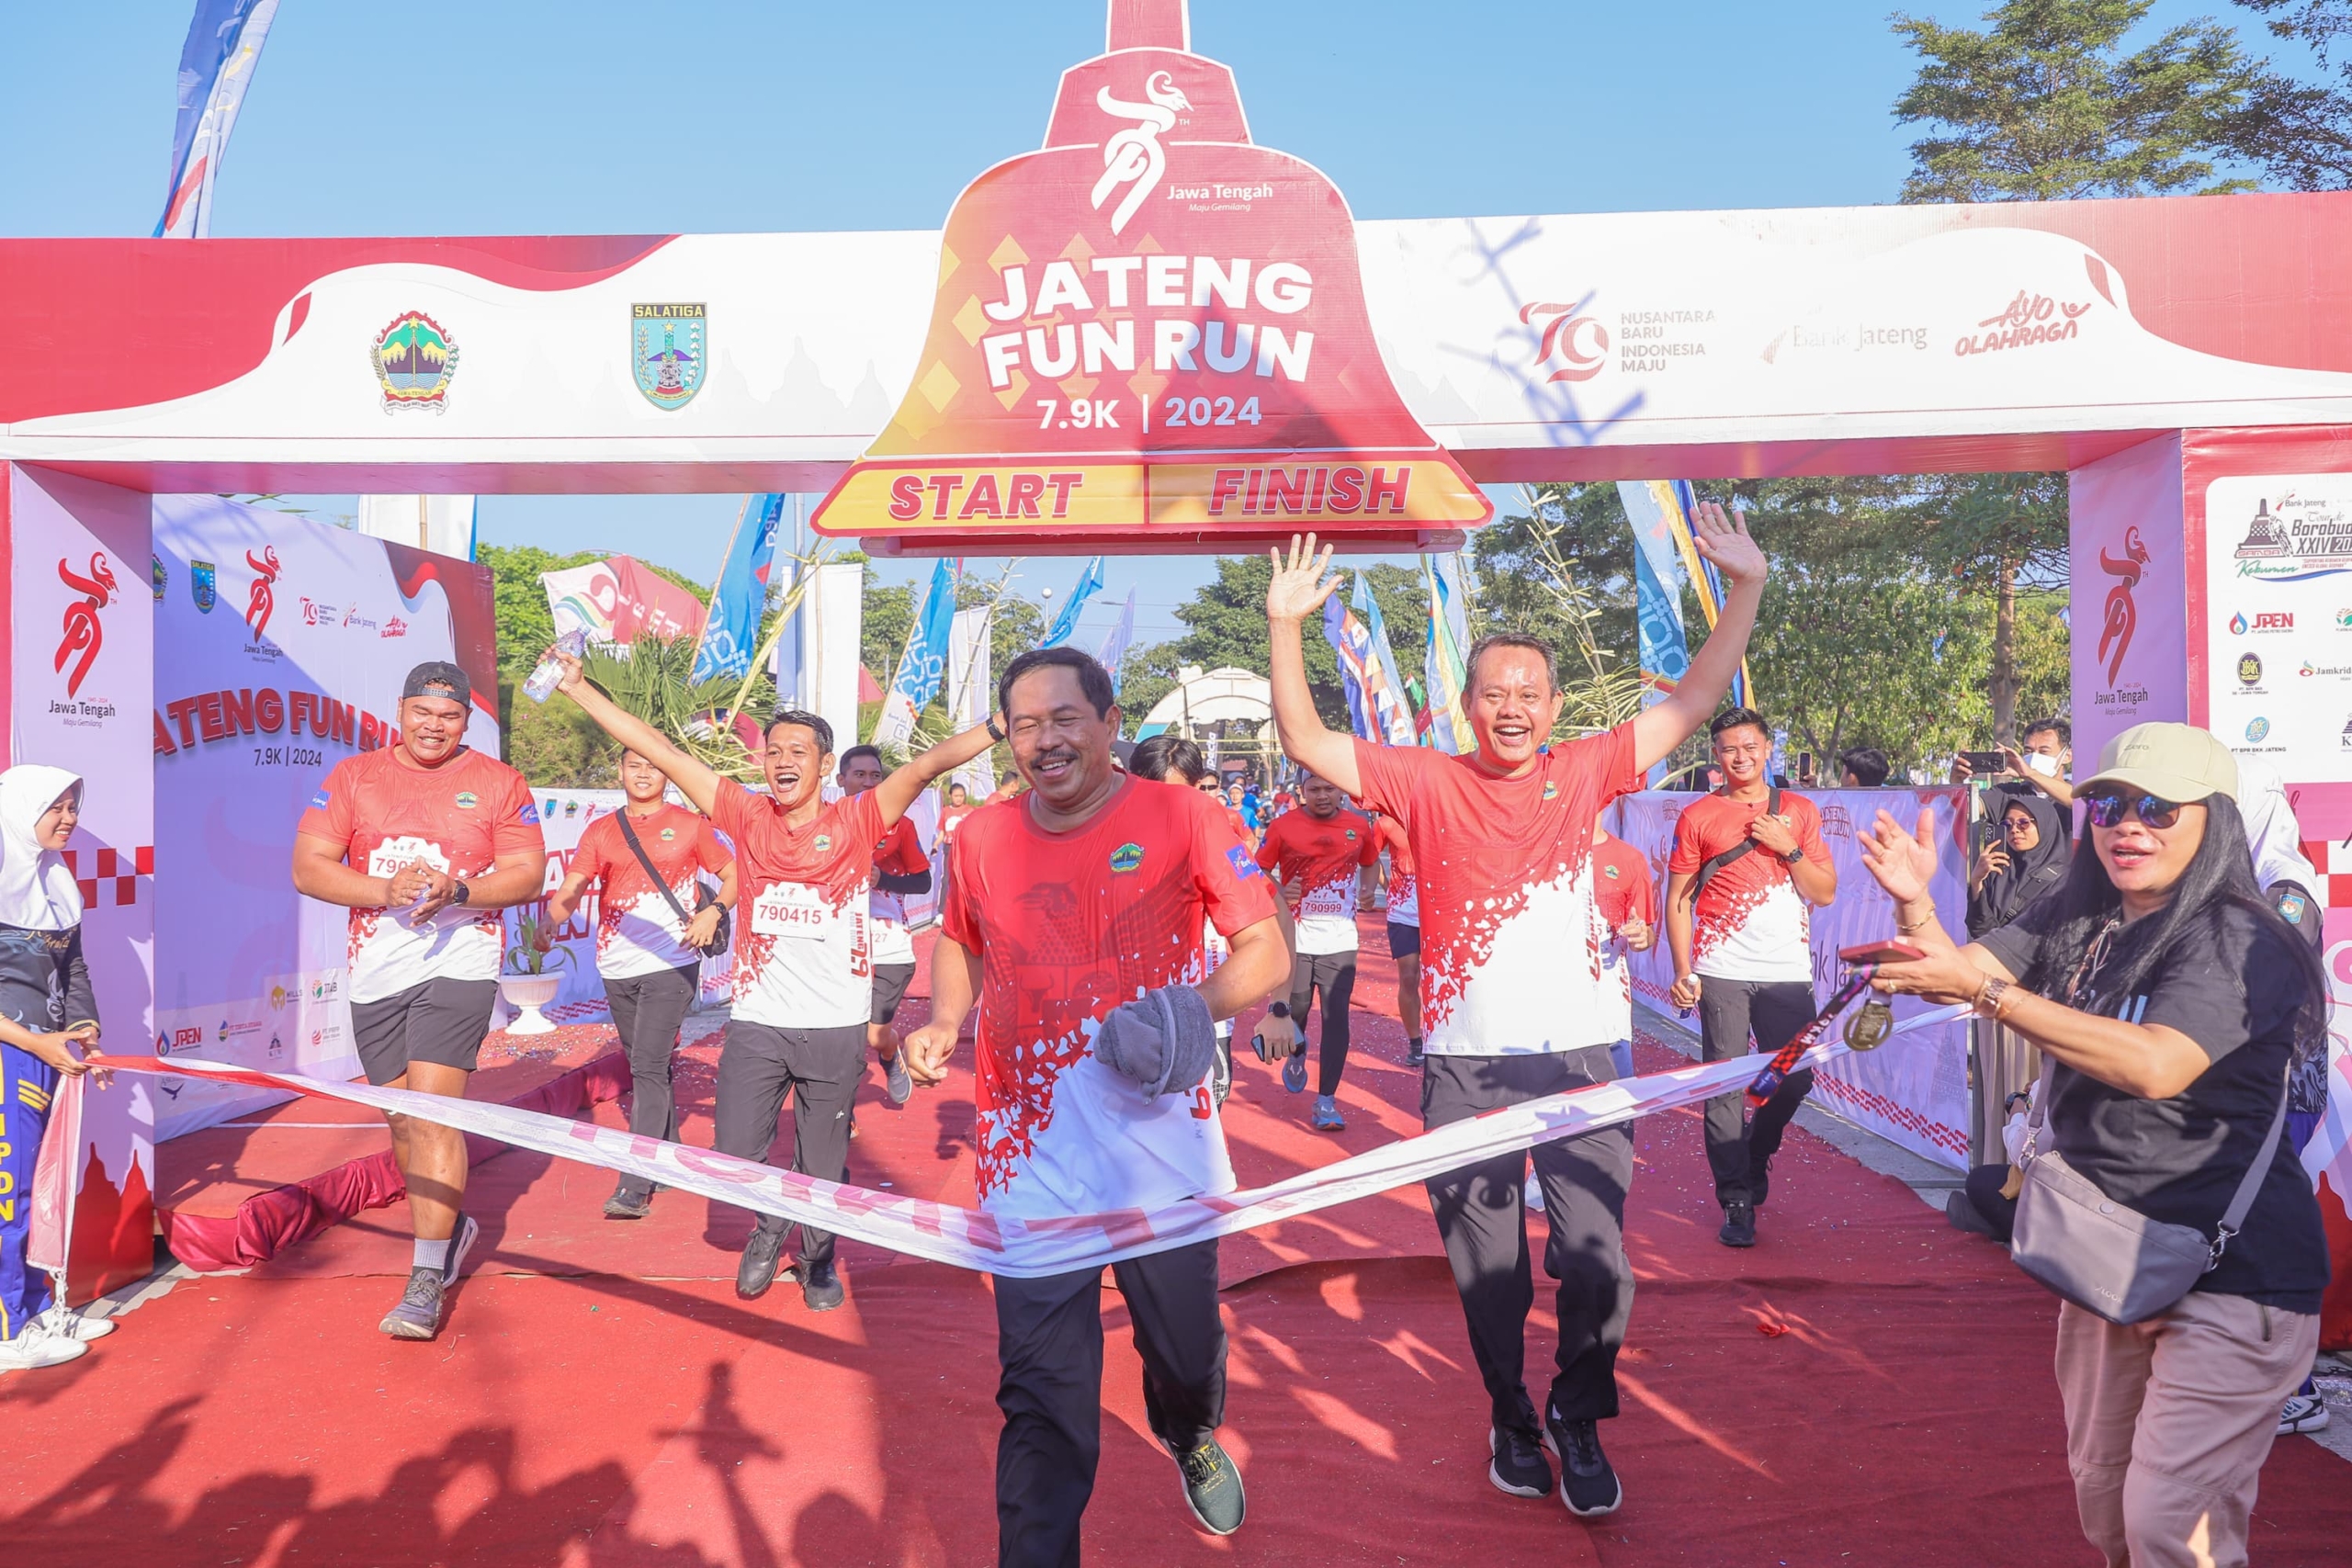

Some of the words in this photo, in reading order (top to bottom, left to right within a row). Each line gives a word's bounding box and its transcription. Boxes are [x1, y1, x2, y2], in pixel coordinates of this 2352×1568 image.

[1167, 185, 1209, 199] Jawa
[1213, 184, 1273, 201] Tengah
[1189, 204, 1210, 212] Maju
[1211, 202, 1251, 212] Gemilang
[985, 255, 1313, 321] JATENG
[635, 305, 703, 317] SALATIGA
[1979, 289, 2054, 327] AYO
[1621, 310, 1715, 325] NUSANTARA
[1621, 326, 1664, 339] BARU
[1793, 325, 1849, 348] Bank
[1854, 322, 1928, 351] Jateng
[1954, 320, 2078, 356] OLAHRAGA
[982, 320, 1134, 388] FUN
[1154, 320, 1314, 382] RUN
[1621, 344, 1706, 358] INDONESIA
[1621, 359, 1666, 372] MAJU
[1036, 399, 1121, 429] 7.9K
[1165, 396, 1262, 427] 2024
[888, 472, 1083, 520] START
[1207, 467, 1413, 515] FINISH
[2304, 499, 2326, 508] Jateng
[2296, 537, 2331, 554] XXIV
[2235, 559, 2299, 578] Kebumen
[2251, 613, 2293, 628] JPEN
[243, 644, 260, 655] Jawa
[261, 646, 284, 658] Tengah
[2095, 691, 2115, 705] Jawa
[2117, 687, 2148, 705] Tengah
[49, 700, 76, 715] Jawa
[79, 702, 116, 718] Tengah
[62, 717, 76, 727] Maju
[77, 718, 103, 728] Gemilang
[288, 690, 355, 747] FUN
[254, 748, 282, 766] 7.9K
[294, 749, 322, 767] 2024
[759, 904, 822, 925] 790415
[1305, 902, 1341, 913] 790999
[854, 912, 864, 950] JATENG
[851, 942, 869, 978] 7.9
[172, 1027, 201, 1047] JPEN
